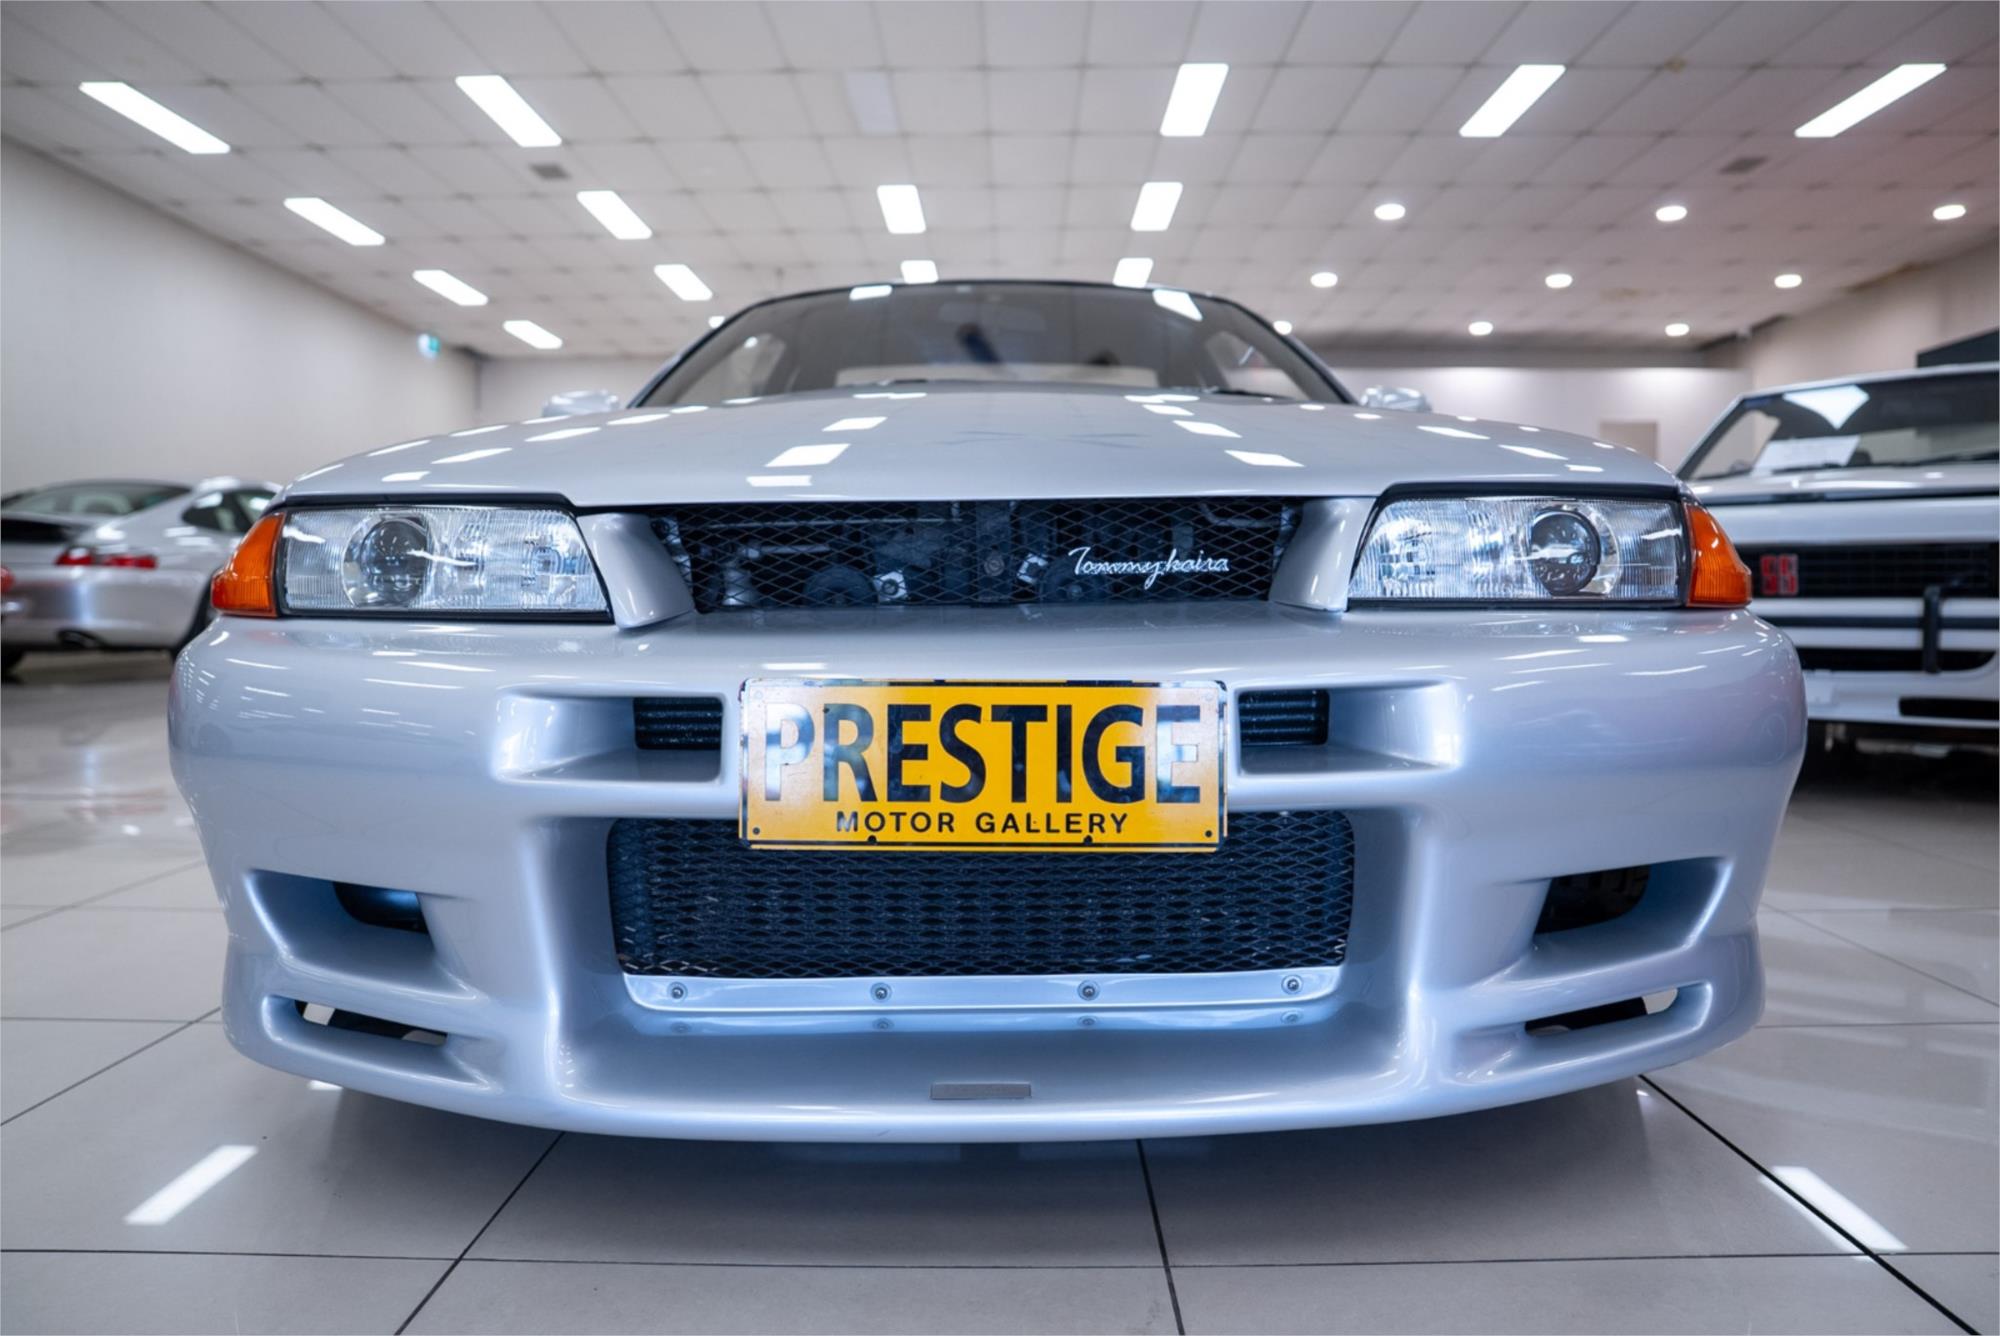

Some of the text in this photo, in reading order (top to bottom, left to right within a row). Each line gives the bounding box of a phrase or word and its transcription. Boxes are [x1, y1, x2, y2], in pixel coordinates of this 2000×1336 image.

[763, 703, 1201, 803] PRESTIGE
[836, 810, 1129, 834] MOTOR GALLERY
